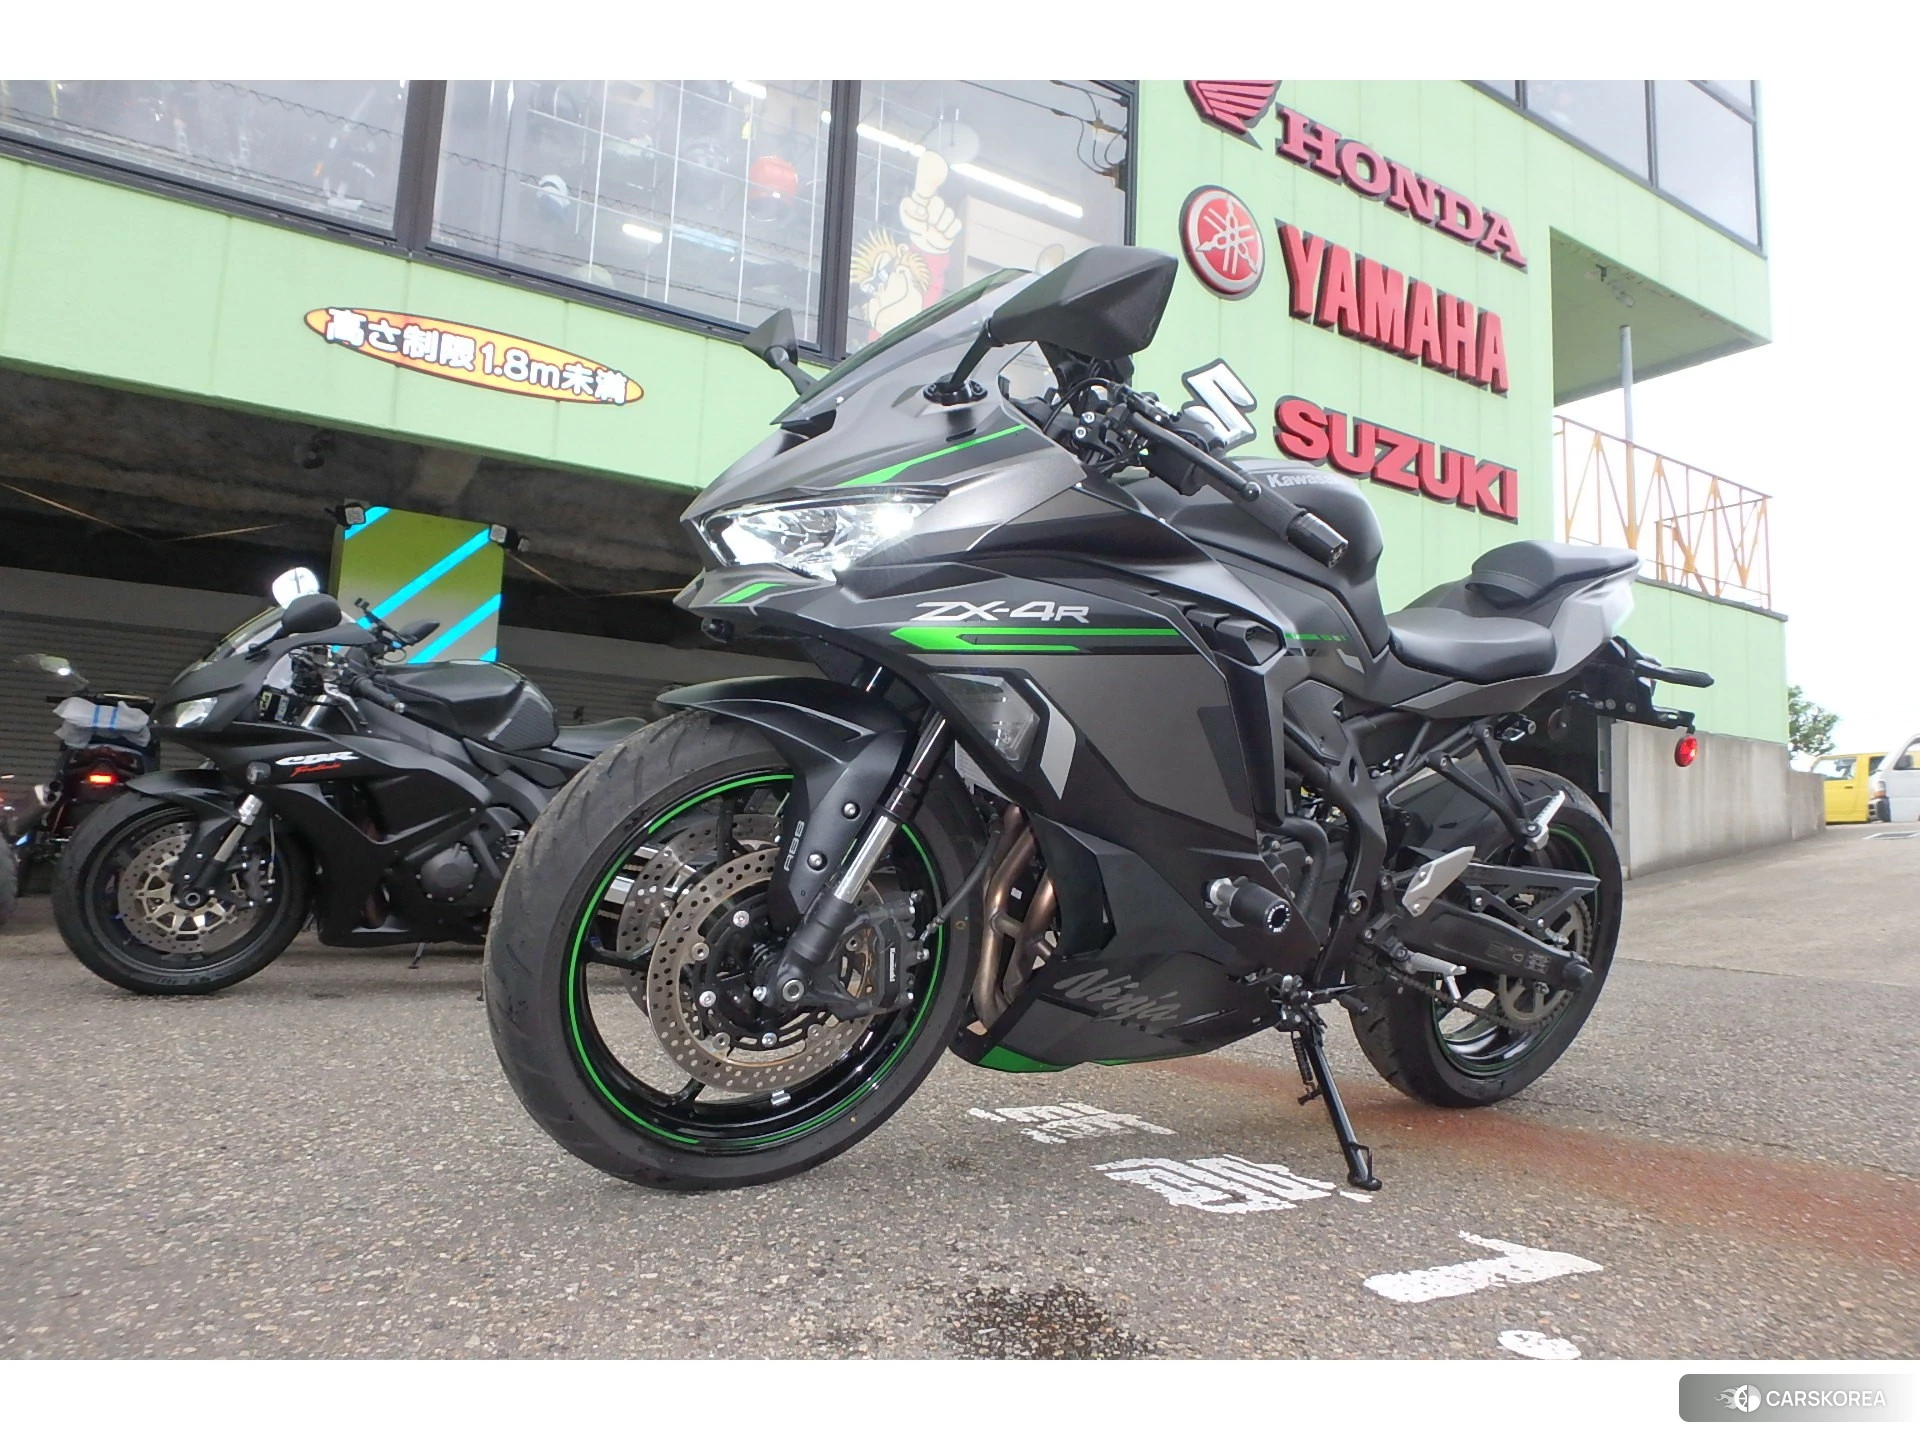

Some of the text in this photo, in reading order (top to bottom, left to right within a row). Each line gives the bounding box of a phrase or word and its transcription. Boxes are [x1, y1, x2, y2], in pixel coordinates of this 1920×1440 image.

[1277, 106, 1528, 270] HONDA
[326, 308, 627, 403] 高さ制限1.8m未満
[1276, 222, 1509, 394] YAMAHA
[1274, 397, 1519, 522] SUZUKI
[910, 600, 1090, 624] ZX-4R
[1053, 968, 1181, 1022] Ninja
